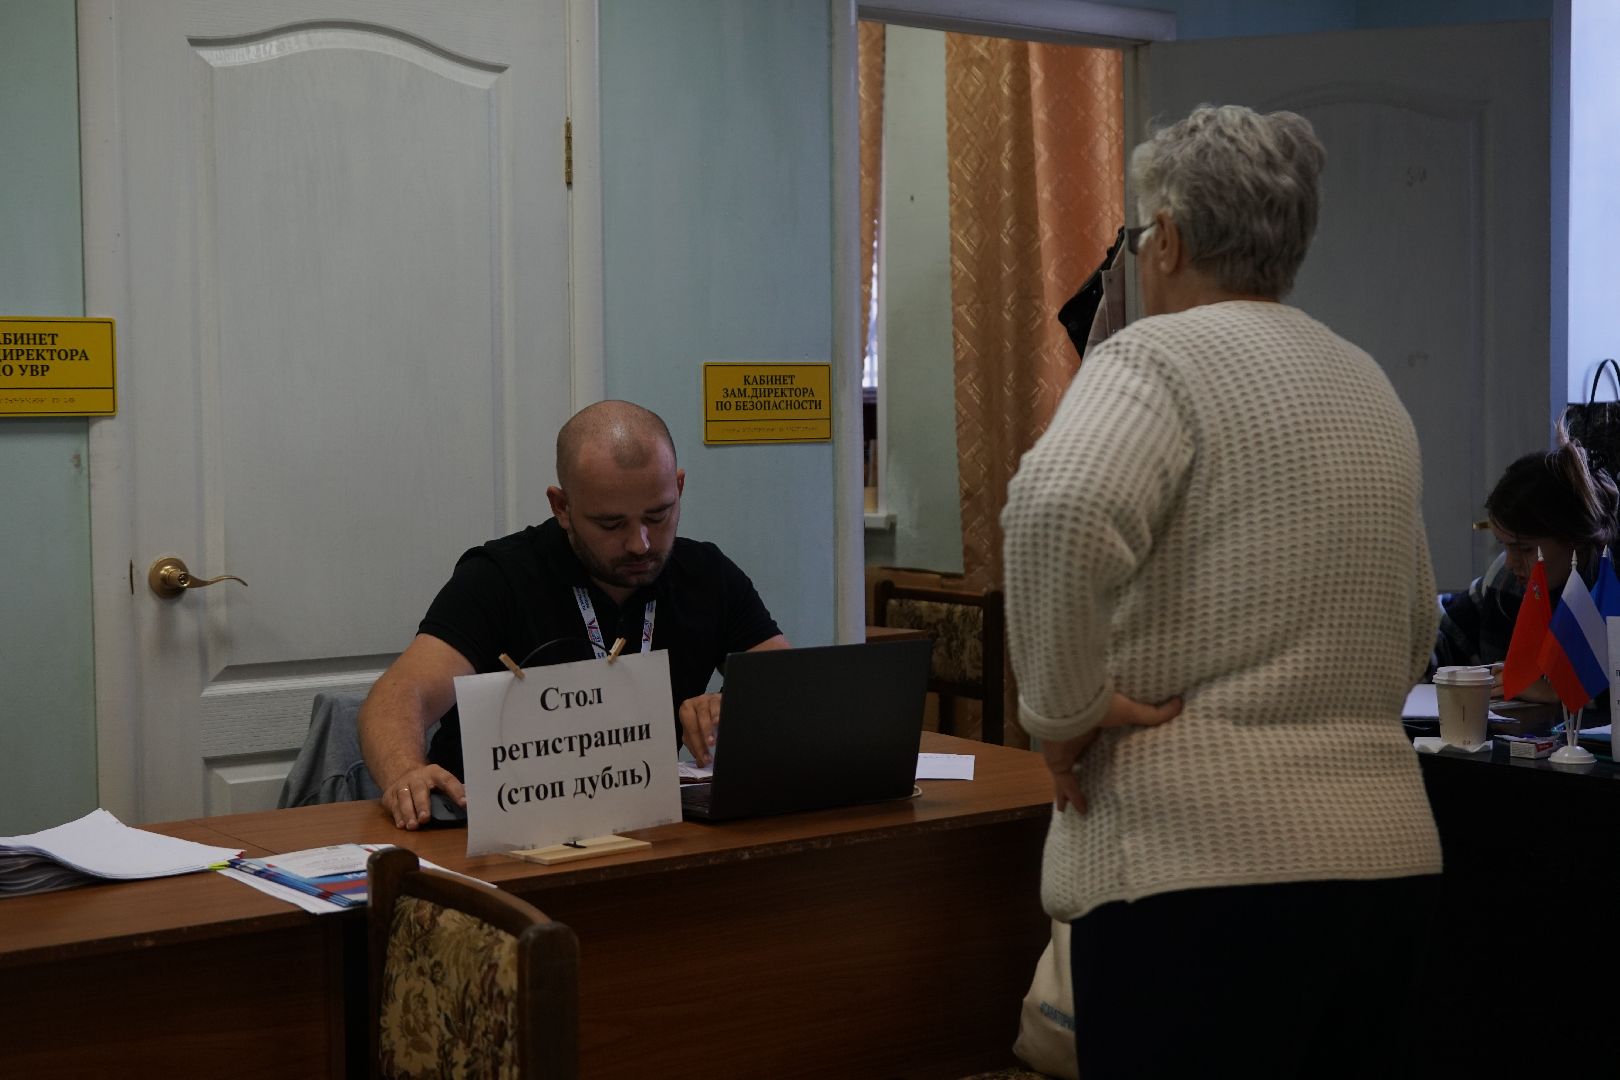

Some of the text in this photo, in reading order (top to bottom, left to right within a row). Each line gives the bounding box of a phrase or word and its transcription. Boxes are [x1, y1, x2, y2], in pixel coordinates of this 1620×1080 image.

[0, 333, 58, 346] БИНЕТ
[0, 348, 90, 362] ИРЕКТОРА
[0, 364, 50, 377] О УВР
[743, 374, 796, 386] КАБИНЕТ
[722, 387, 815, 399] ЗАМ.ДИРЕКТОРА
[715, 399, 822, 411] ПО БЕЗОПАСНОСТИ
[540, 687, 603, 711] Стол
[492, 722, 652, 771] регистрации
[497, 759, 652, 812] (стоп дубль)
